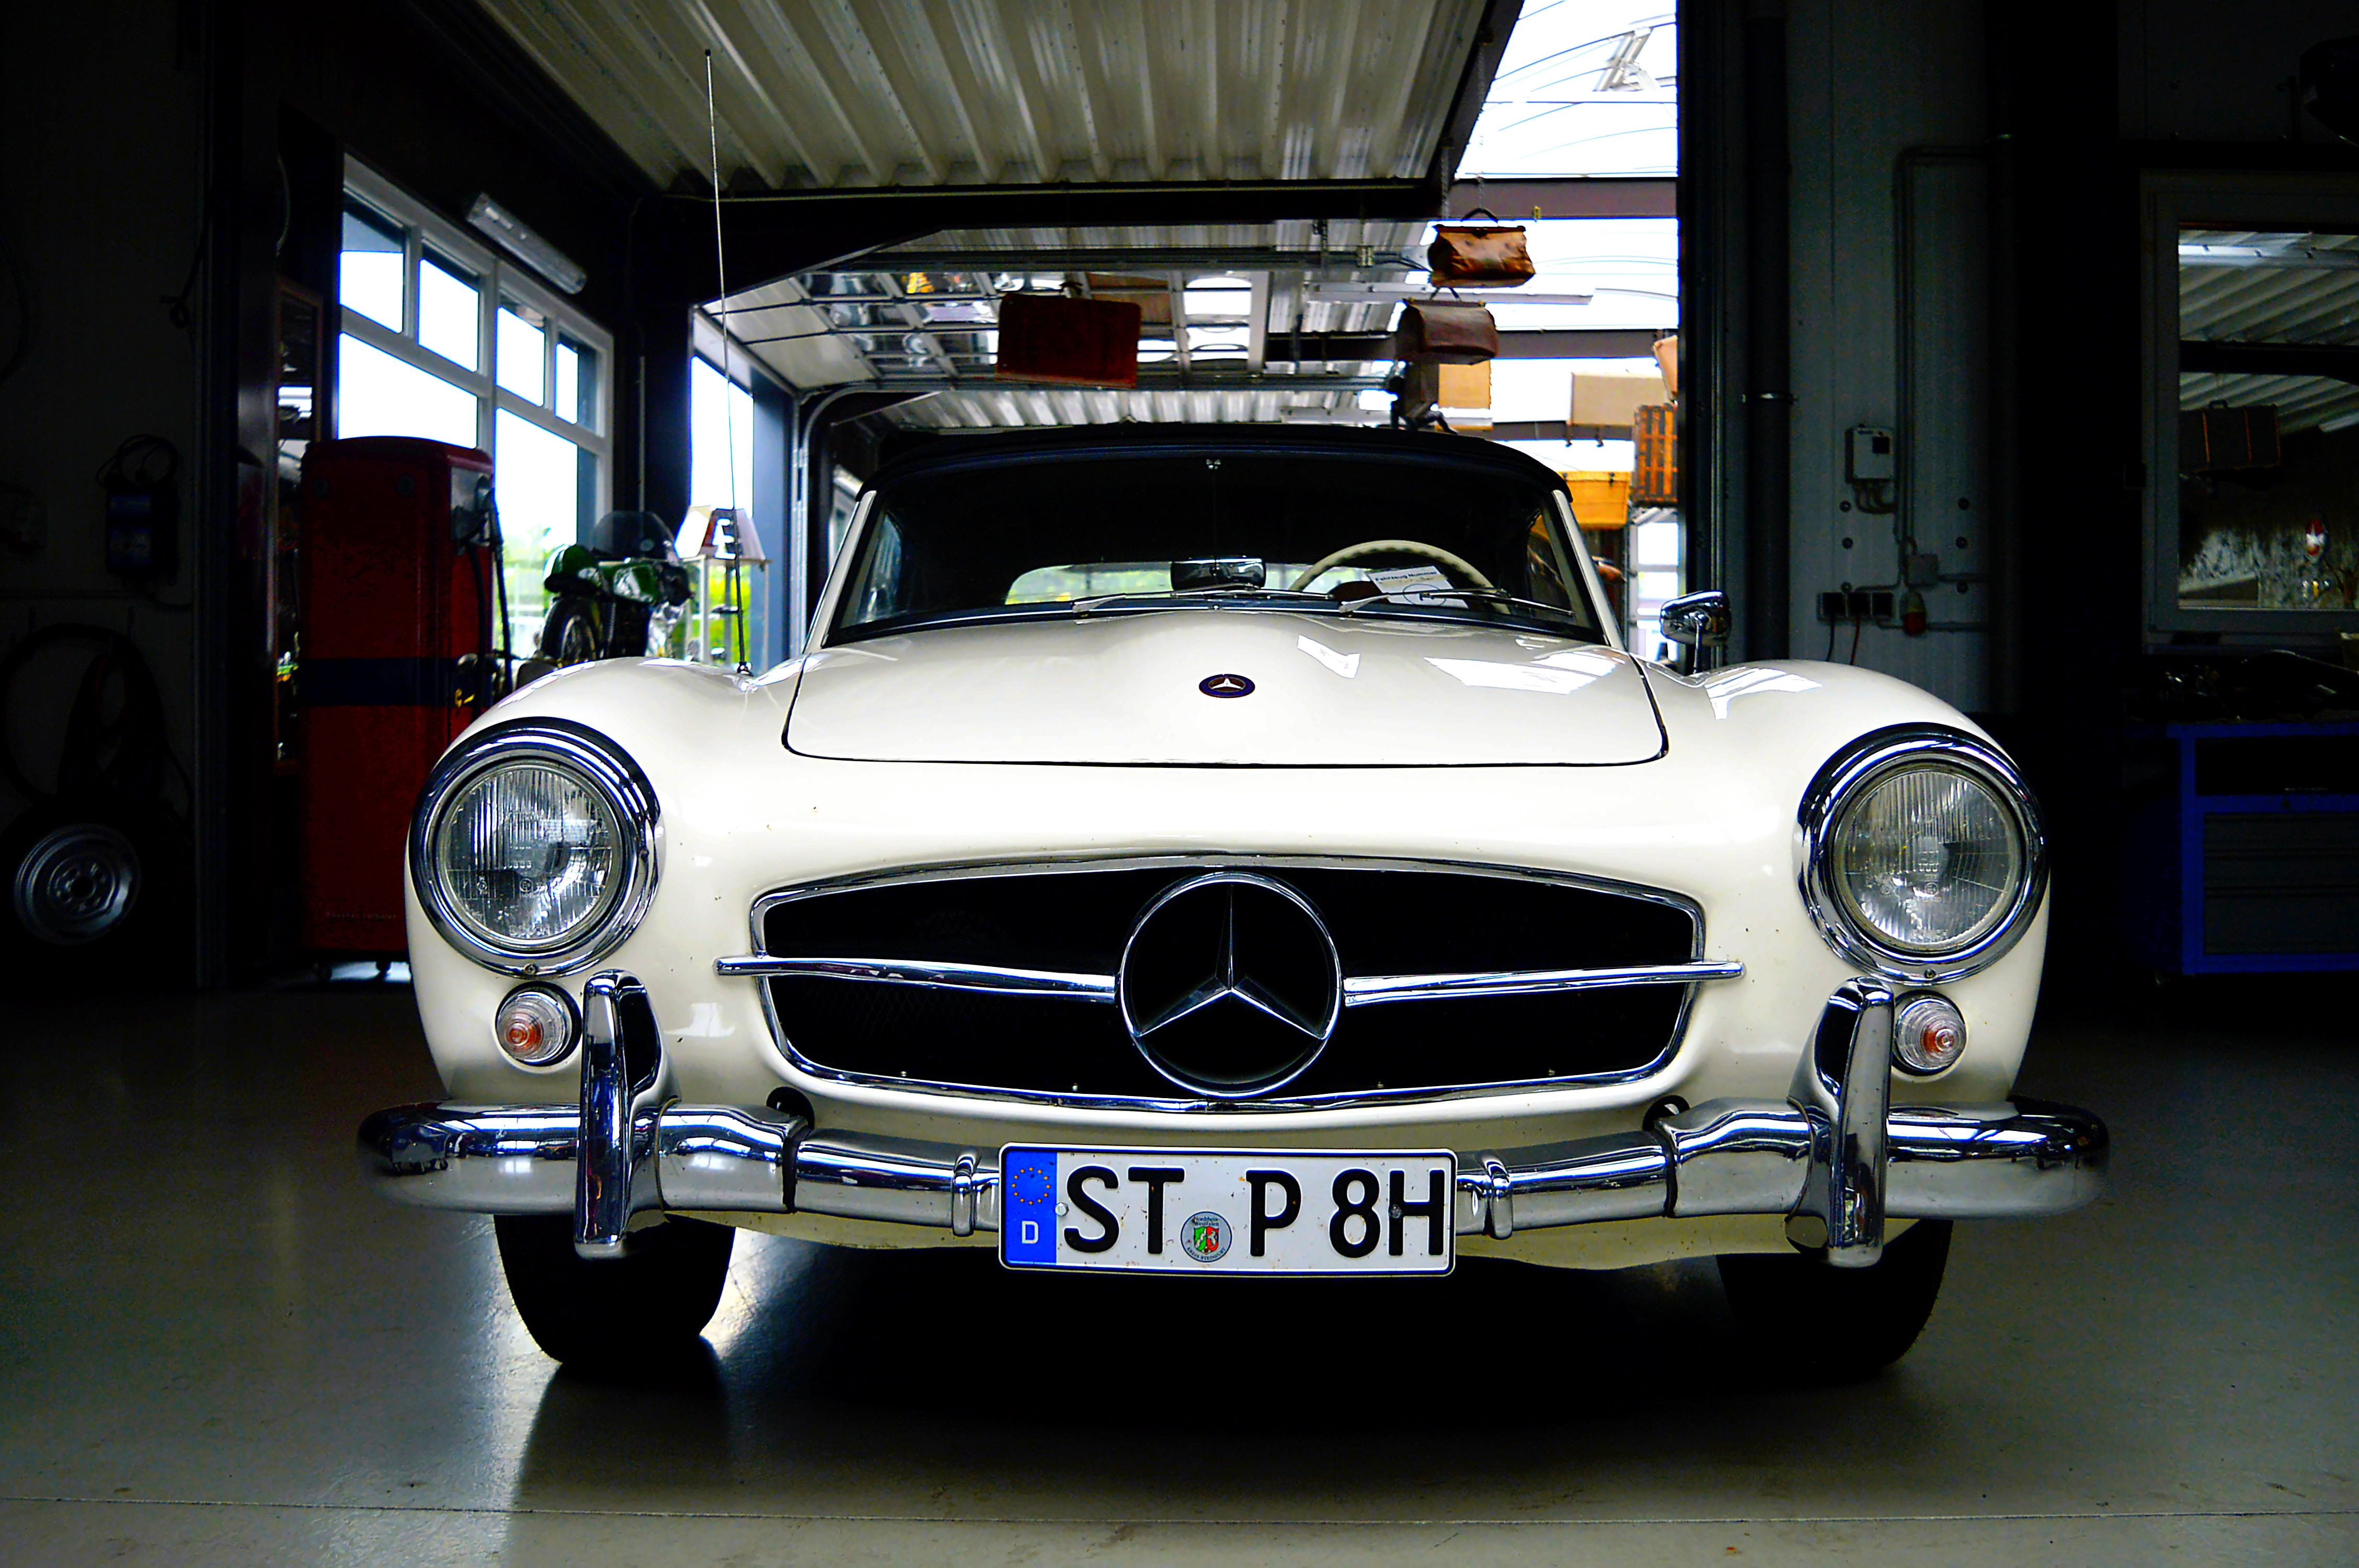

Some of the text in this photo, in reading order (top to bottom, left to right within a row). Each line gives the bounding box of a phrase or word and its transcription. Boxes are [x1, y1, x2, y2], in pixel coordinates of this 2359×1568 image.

[1022, 1220, 1038, 1244] D
[1064, 1165, 1445, 1259] ST P 8H
